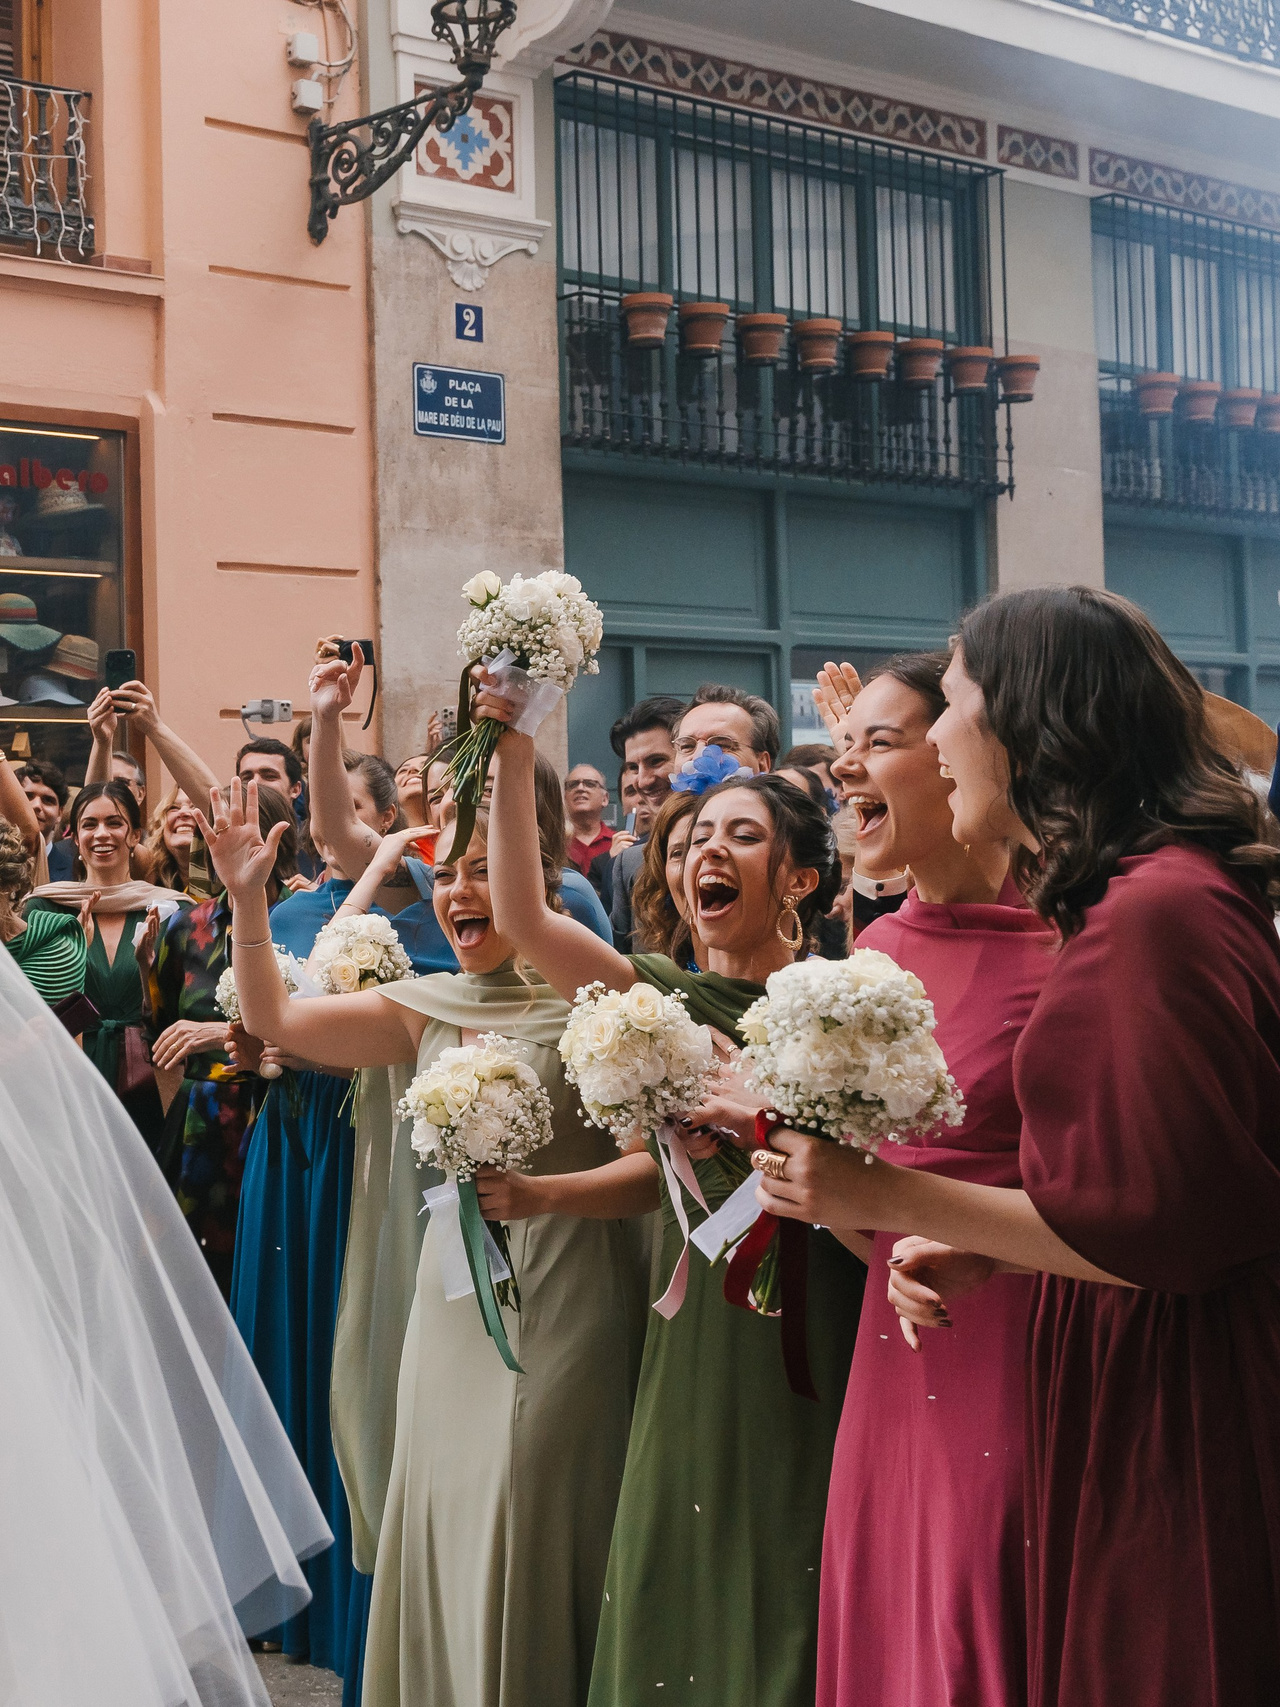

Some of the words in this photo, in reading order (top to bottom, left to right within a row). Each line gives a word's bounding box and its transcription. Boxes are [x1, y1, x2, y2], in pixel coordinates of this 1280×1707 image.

[463, 308, 476, 337] 2
[448, 379, 482, 395] PLAÇA
[444, 396, 459, 407] DE
[460, 398, 474, 409] LA
[418, 410, 438, 425] MARE
[439, 412, 450, 426] DE
[450, 411, 465, 428] DÉU
[465, 416, 476, 429] DE
[476, 418, 486, 430] LA
[486, 419, 502, 432] PAU
